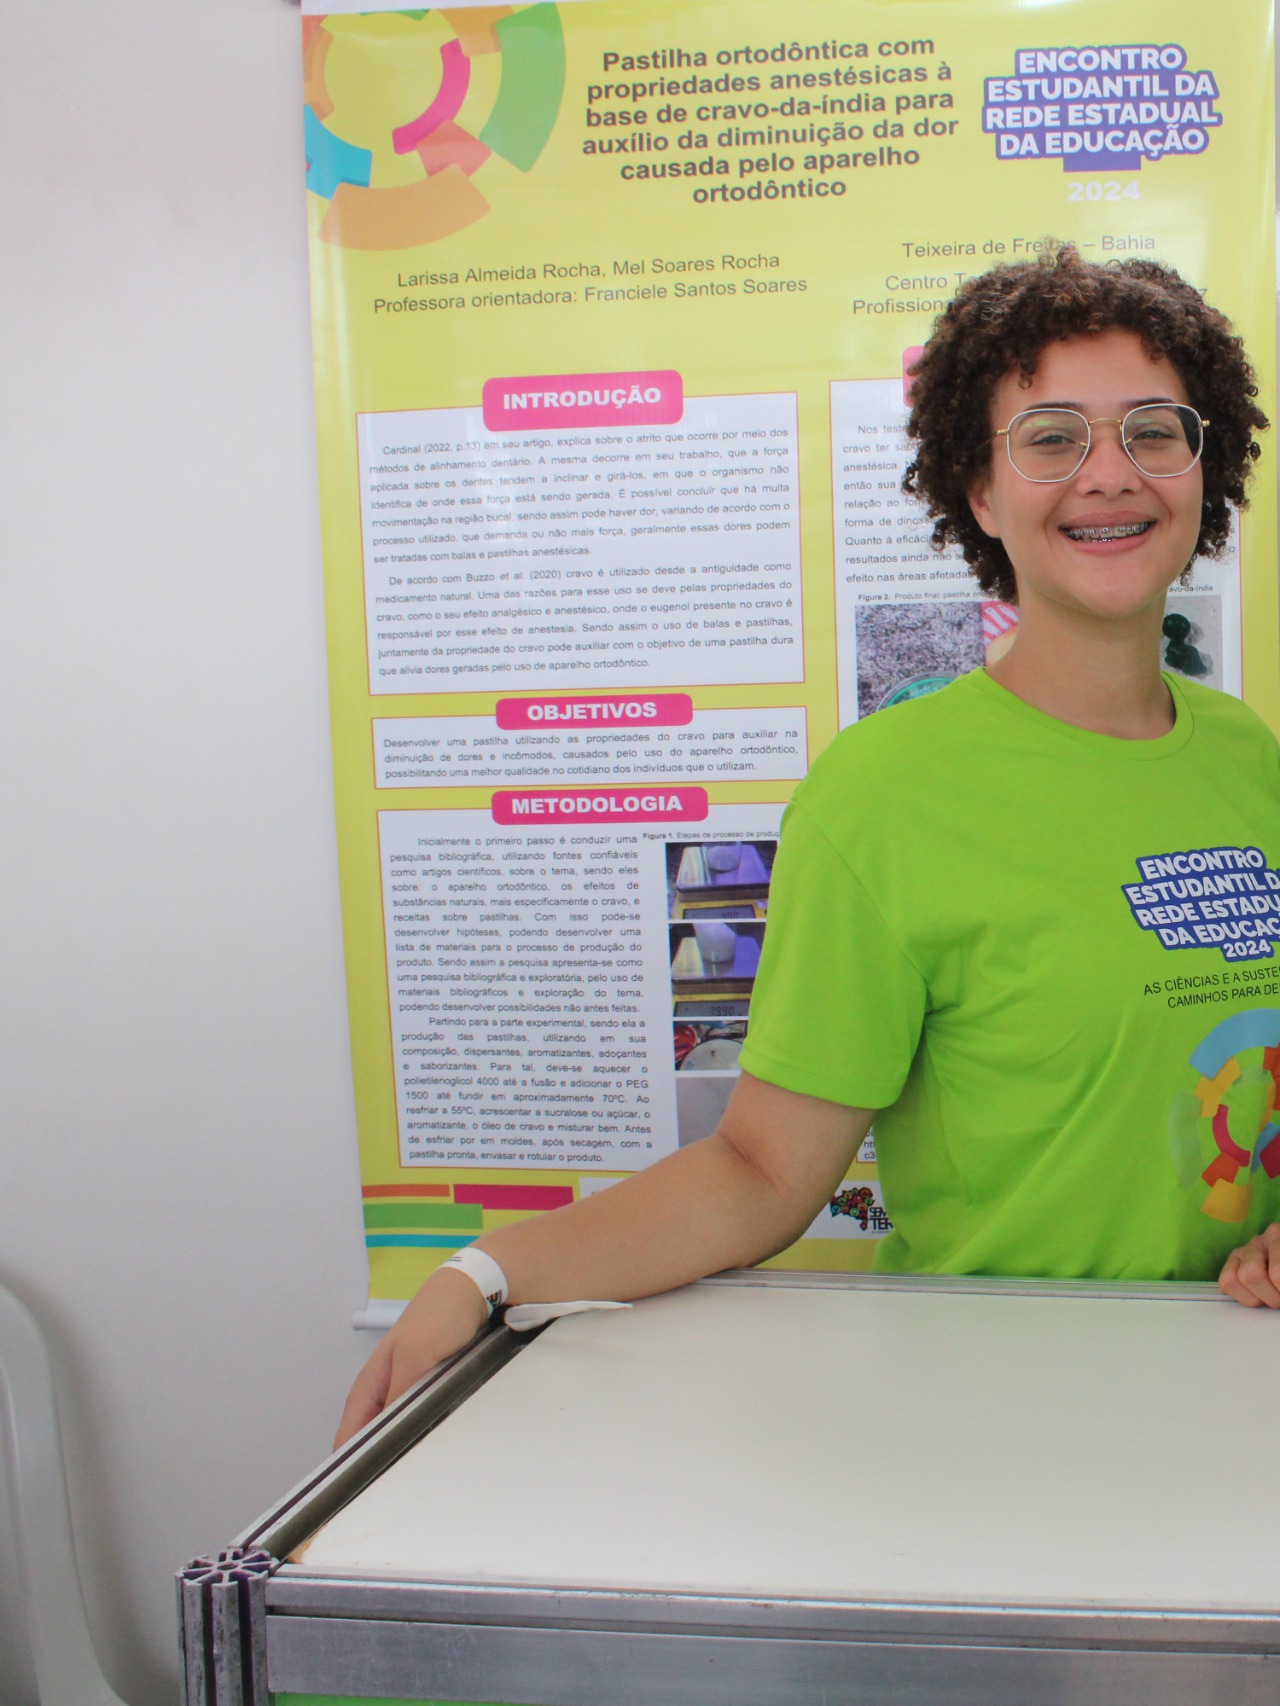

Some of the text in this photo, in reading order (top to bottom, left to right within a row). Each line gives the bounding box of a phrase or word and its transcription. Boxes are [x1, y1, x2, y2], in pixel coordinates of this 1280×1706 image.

[603, 39, 934, 72] Pastilha ortodôntica com
[1020, 48, 1182, 73] ENCONTRO
[587, 61, 951, 103] propriedades anestésicas à
[988, 74, 1214, 102] ESTUDANTIL DA
[586, 92, 953, 127] base de cravo-da-índia para
[987, 102, 1218, 129] REDE ESTADUAL
[583, 117, 959, 155] auxílio da diminuição da dor
[1000, 124, 1205, 156] DA EDUCAÇÃO
[621, 147, 920, 180] causada pelo aparelho
[693, 179, 846, 203] ortodôntico
[1067, 181, 1140, 201] 2024
[902, 241, 975, 258] Teixeira
[983, 239, 1005, 255] de
[1102, 235, 1155, 250] Bahia
[398, 253, 779, 288] Larissa Almeida Rocha, Mel Soares Rocha
[886, 275, 947, 291] Centro
[374, 278, 807, 314] Professora orientadora: Franciele Santos Soares
[504, 386, 661, 409] INTRODUÇÃO
[845, 537, 882, 546] Quanto
[846, 555, 898, 564] resultados
[901, 553, 929, 562] ainda
[846, 573, 873, 583] efeito
[877, 573, 895, 581] nas
[899, 572, 926, 581] áreas
[379, 667, 397, 677] que
[399, 666, 423, 675] alivia
[425, 665, 450, 674] dores
[452, 664, 489, 676] geradas
[492, 662, 511, 673] pelo
[514, 663, 531, 671] uso
[534, 662, 546, 671] de
[549, 660, 591, 672] aparelho
[527, 702, 657, 721] OBJETIVOS
[384, 729, 797, 748] Desenvolver uma pastilha utilizando as propriedades do cravo para auxiliar na
[384, 753, 433, 764] diminuição
[440, 753, 451, 762] de
[458, 752, 483, 762] dores
[490, 753, 495, 761] e
[563, 749, 609, 759] causados
[616, 748, 637, 759] pelo
[645, 750, 662, 758] uso
[670, 747, 682, 756] do
[690, 745, 733, 758] aparelho
[386, 768, 447, 780] possibilitando
[450, 769, 469, 777] uma
[471, 767, 502, 777] melhor
[505, 766, 550, 777] qualidade
[553, 767, 564, 775] no
[567, 765, 610, 775] cotidiano
[613, 764, 631, 774] dos
[634, 763, 683, 773] indivíduos
[686, 764, 704, 774] que
[707, 763, 714, 771] o
[512, 795, 683, 814] METODOLOGIA
[1141, 850, 1264, 880] ENCONTRO
[1126, 874, 1267, 905] ESTUDANTIL
[1135, 903, 1199, 926] REDE
[1159, 927, 1195, 945] DA
[1224, 939, 1271, 957] 2024
[1144, 982, 1161, 995] AS
[1165, 974, 1219, 991] CIÊNCIAS
[1223, 973, 1229, 983] E
[1233, 972, 1240, 982] A
[1168, 992, 1228, 1008] CAMINHOS
[1232, 986, 1261, 999] PARA
[409, 1150, 445, 1160] pastilha
[480, 1152, 517, 1160] envasar
[527, 1152, 556, 1161] rotular
[558, 1154, 564, 1162] o
